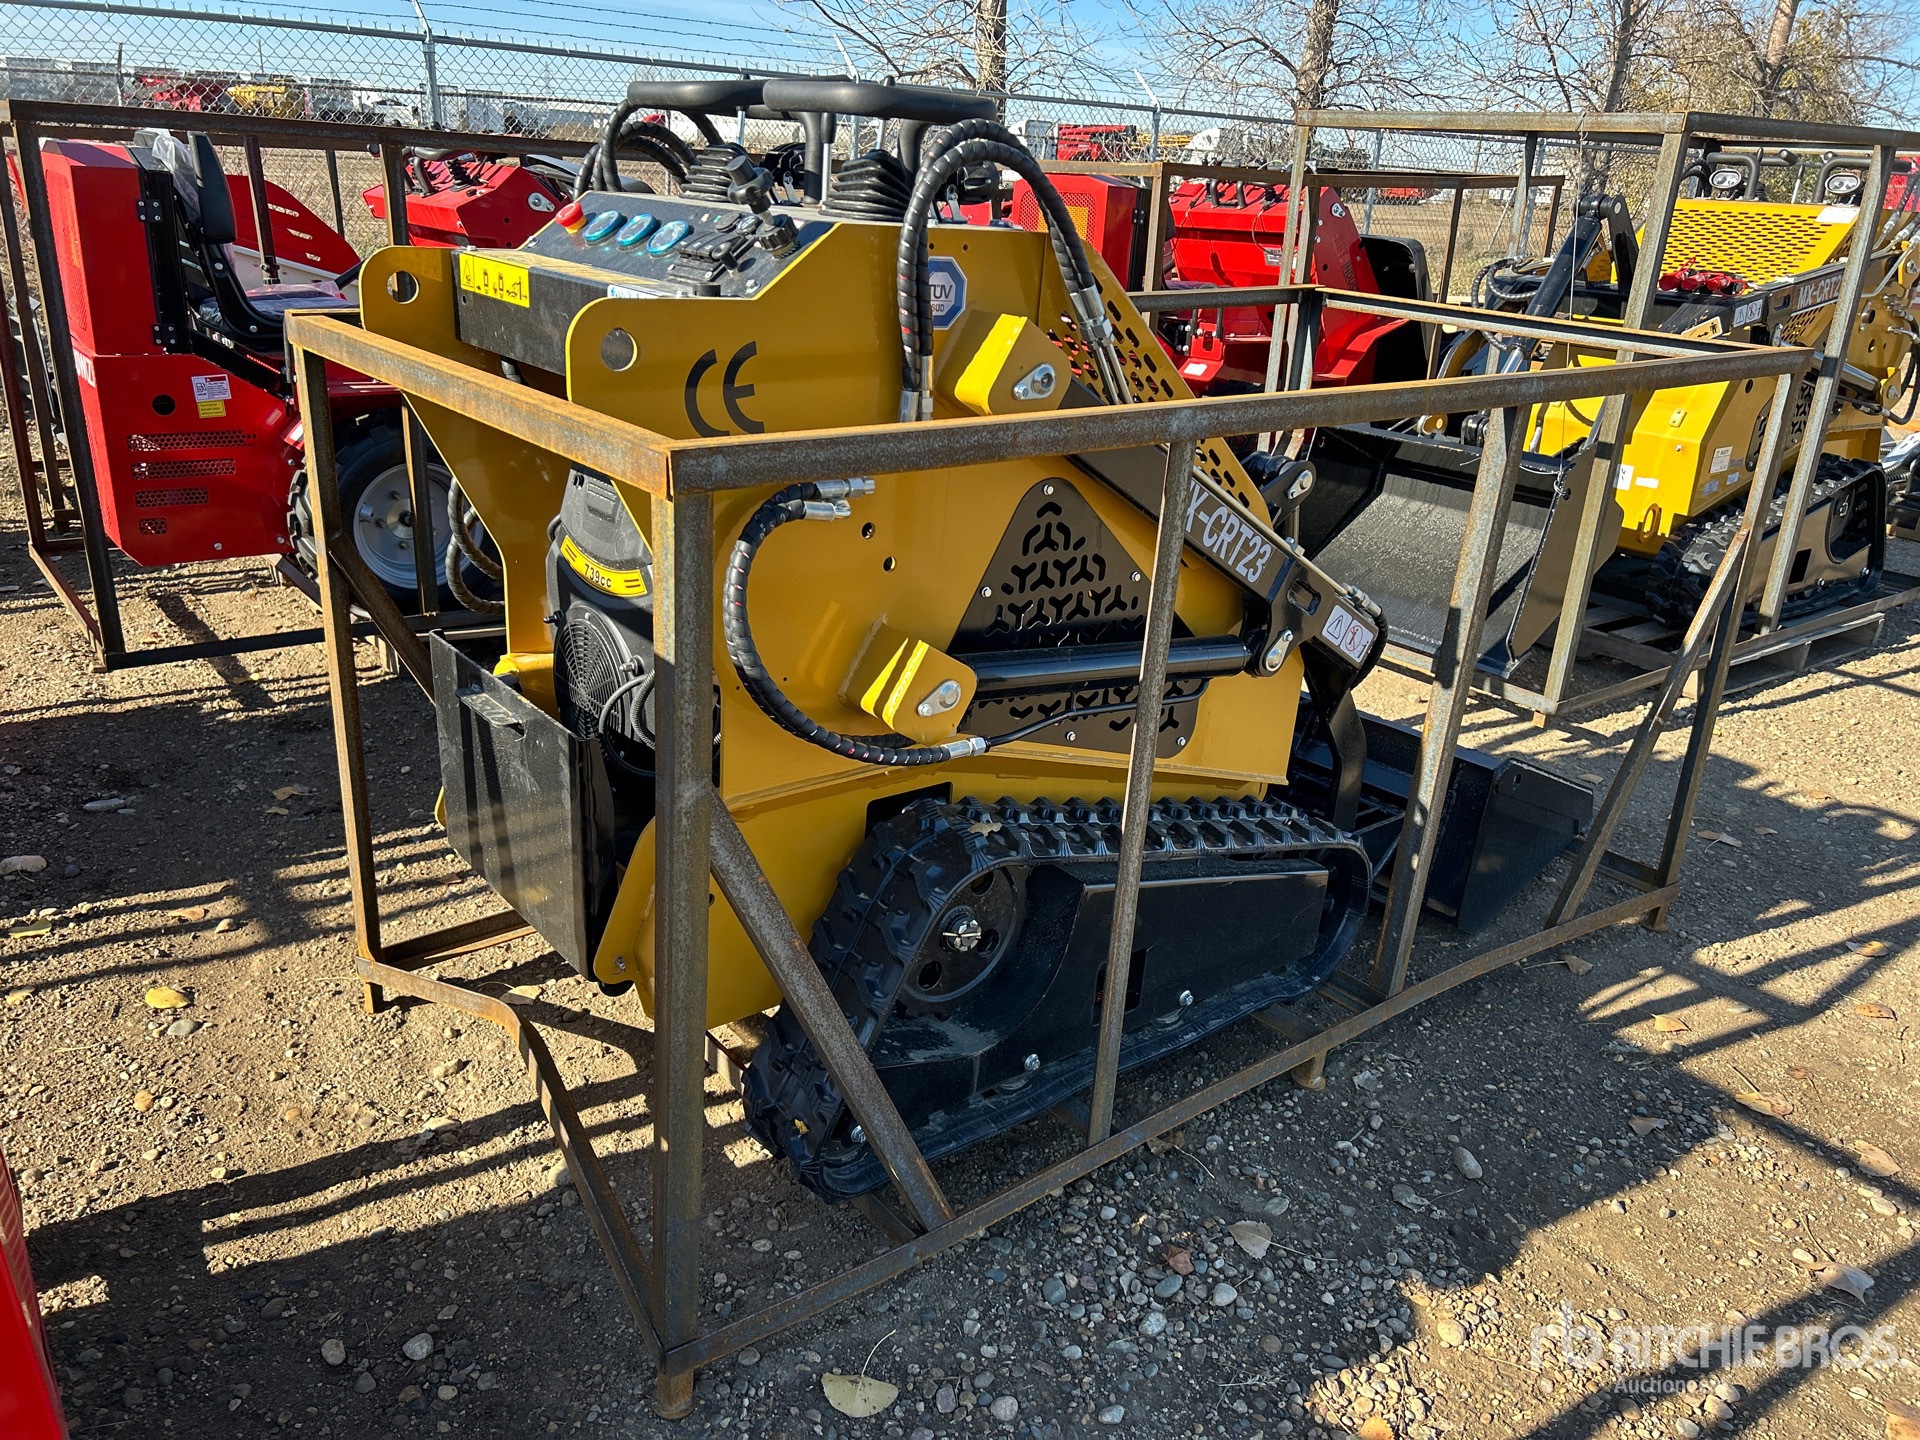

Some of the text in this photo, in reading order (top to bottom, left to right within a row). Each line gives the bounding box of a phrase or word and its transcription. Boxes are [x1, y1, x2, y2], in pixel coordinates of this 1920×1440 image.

[1797, 274, 1842, 310] MX-CRT2
[684, 340, 765, 438] CE
[1184, 479, 1272, 583] X-CRT23
[584, 563, 612, 588] 739cc
